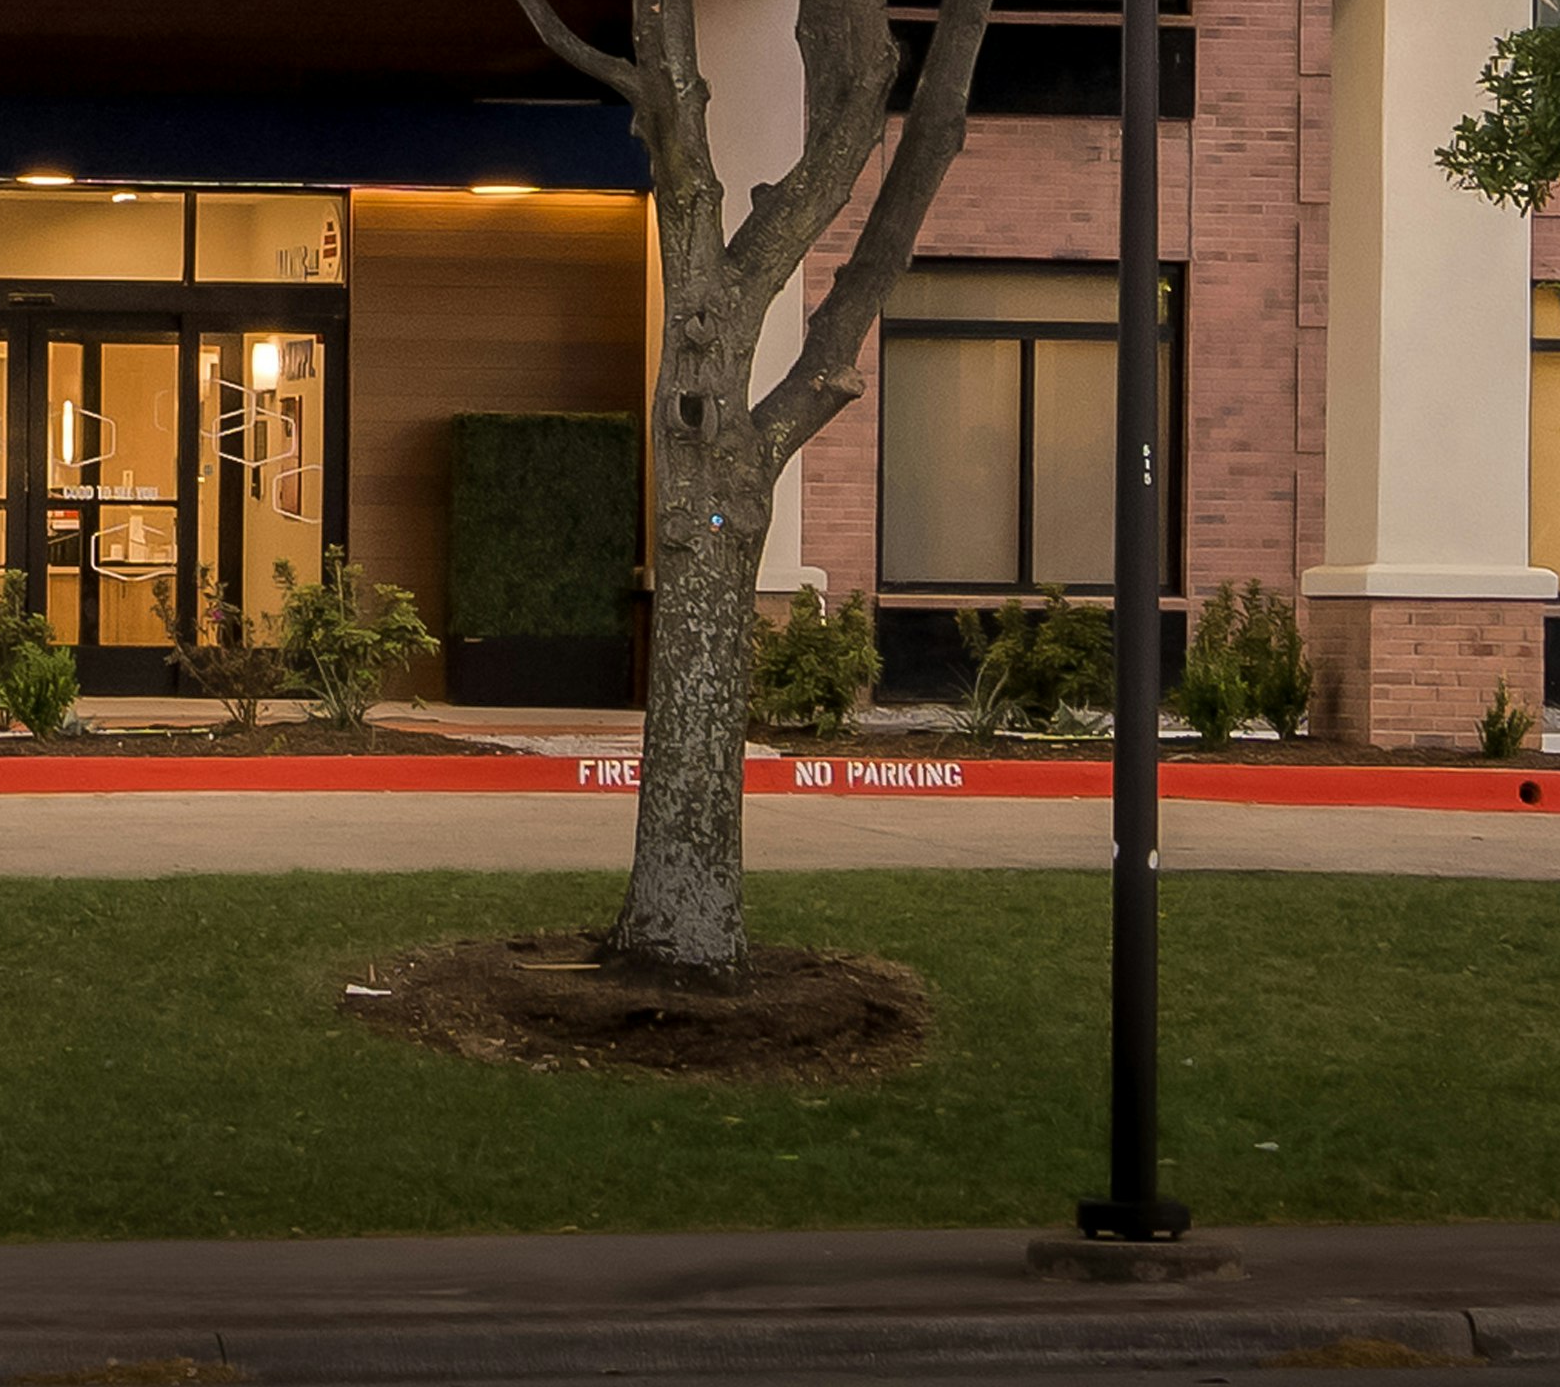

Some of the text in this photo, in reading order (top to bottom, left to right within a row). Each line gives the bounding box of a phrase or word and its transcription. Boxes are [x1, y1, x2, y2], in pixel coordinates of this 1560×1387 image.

[579, 759, 963, 789] FIRE NO PARKING
